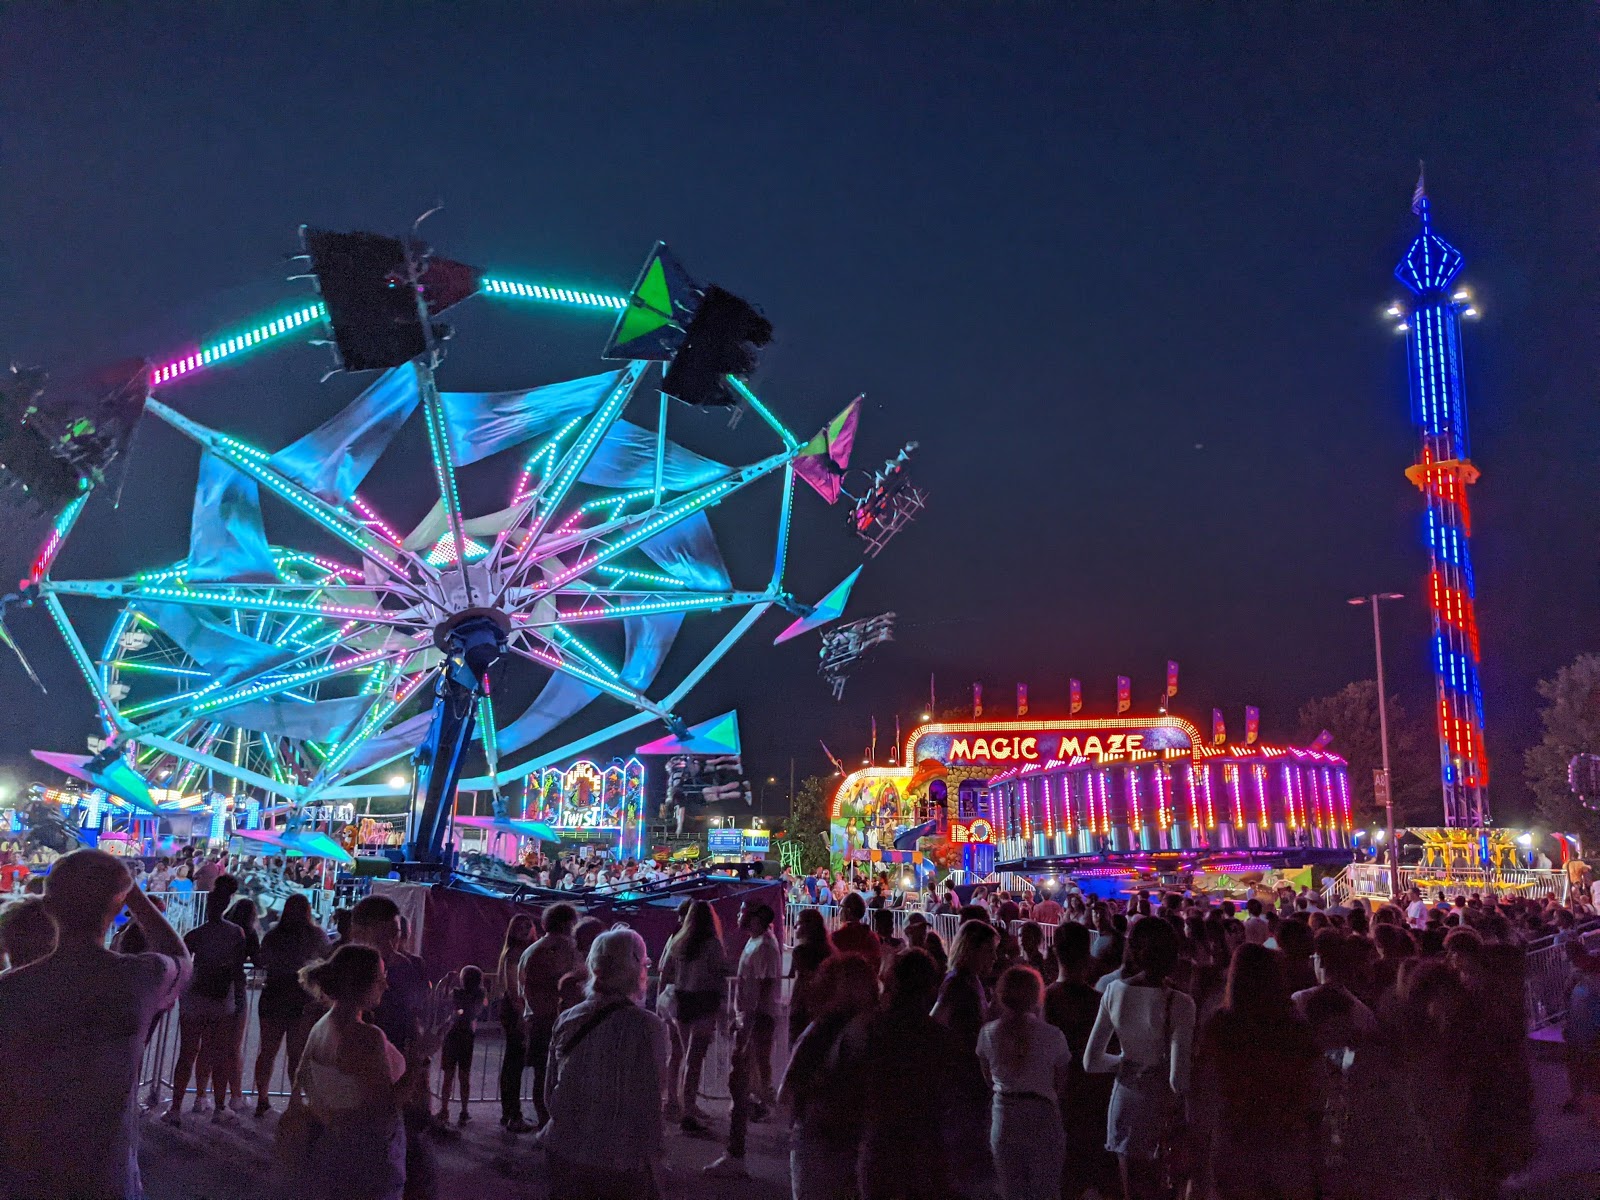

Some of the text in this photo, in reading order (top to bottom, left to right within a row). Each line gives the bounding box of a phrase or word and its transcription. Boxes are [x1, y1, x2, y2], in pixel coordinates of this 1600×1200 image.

[949, 734, 1145, 759] MAGIC MAZE
[564, 763, 601, 791] JUNGLE
[563, 806, 601, 827] TWIST
